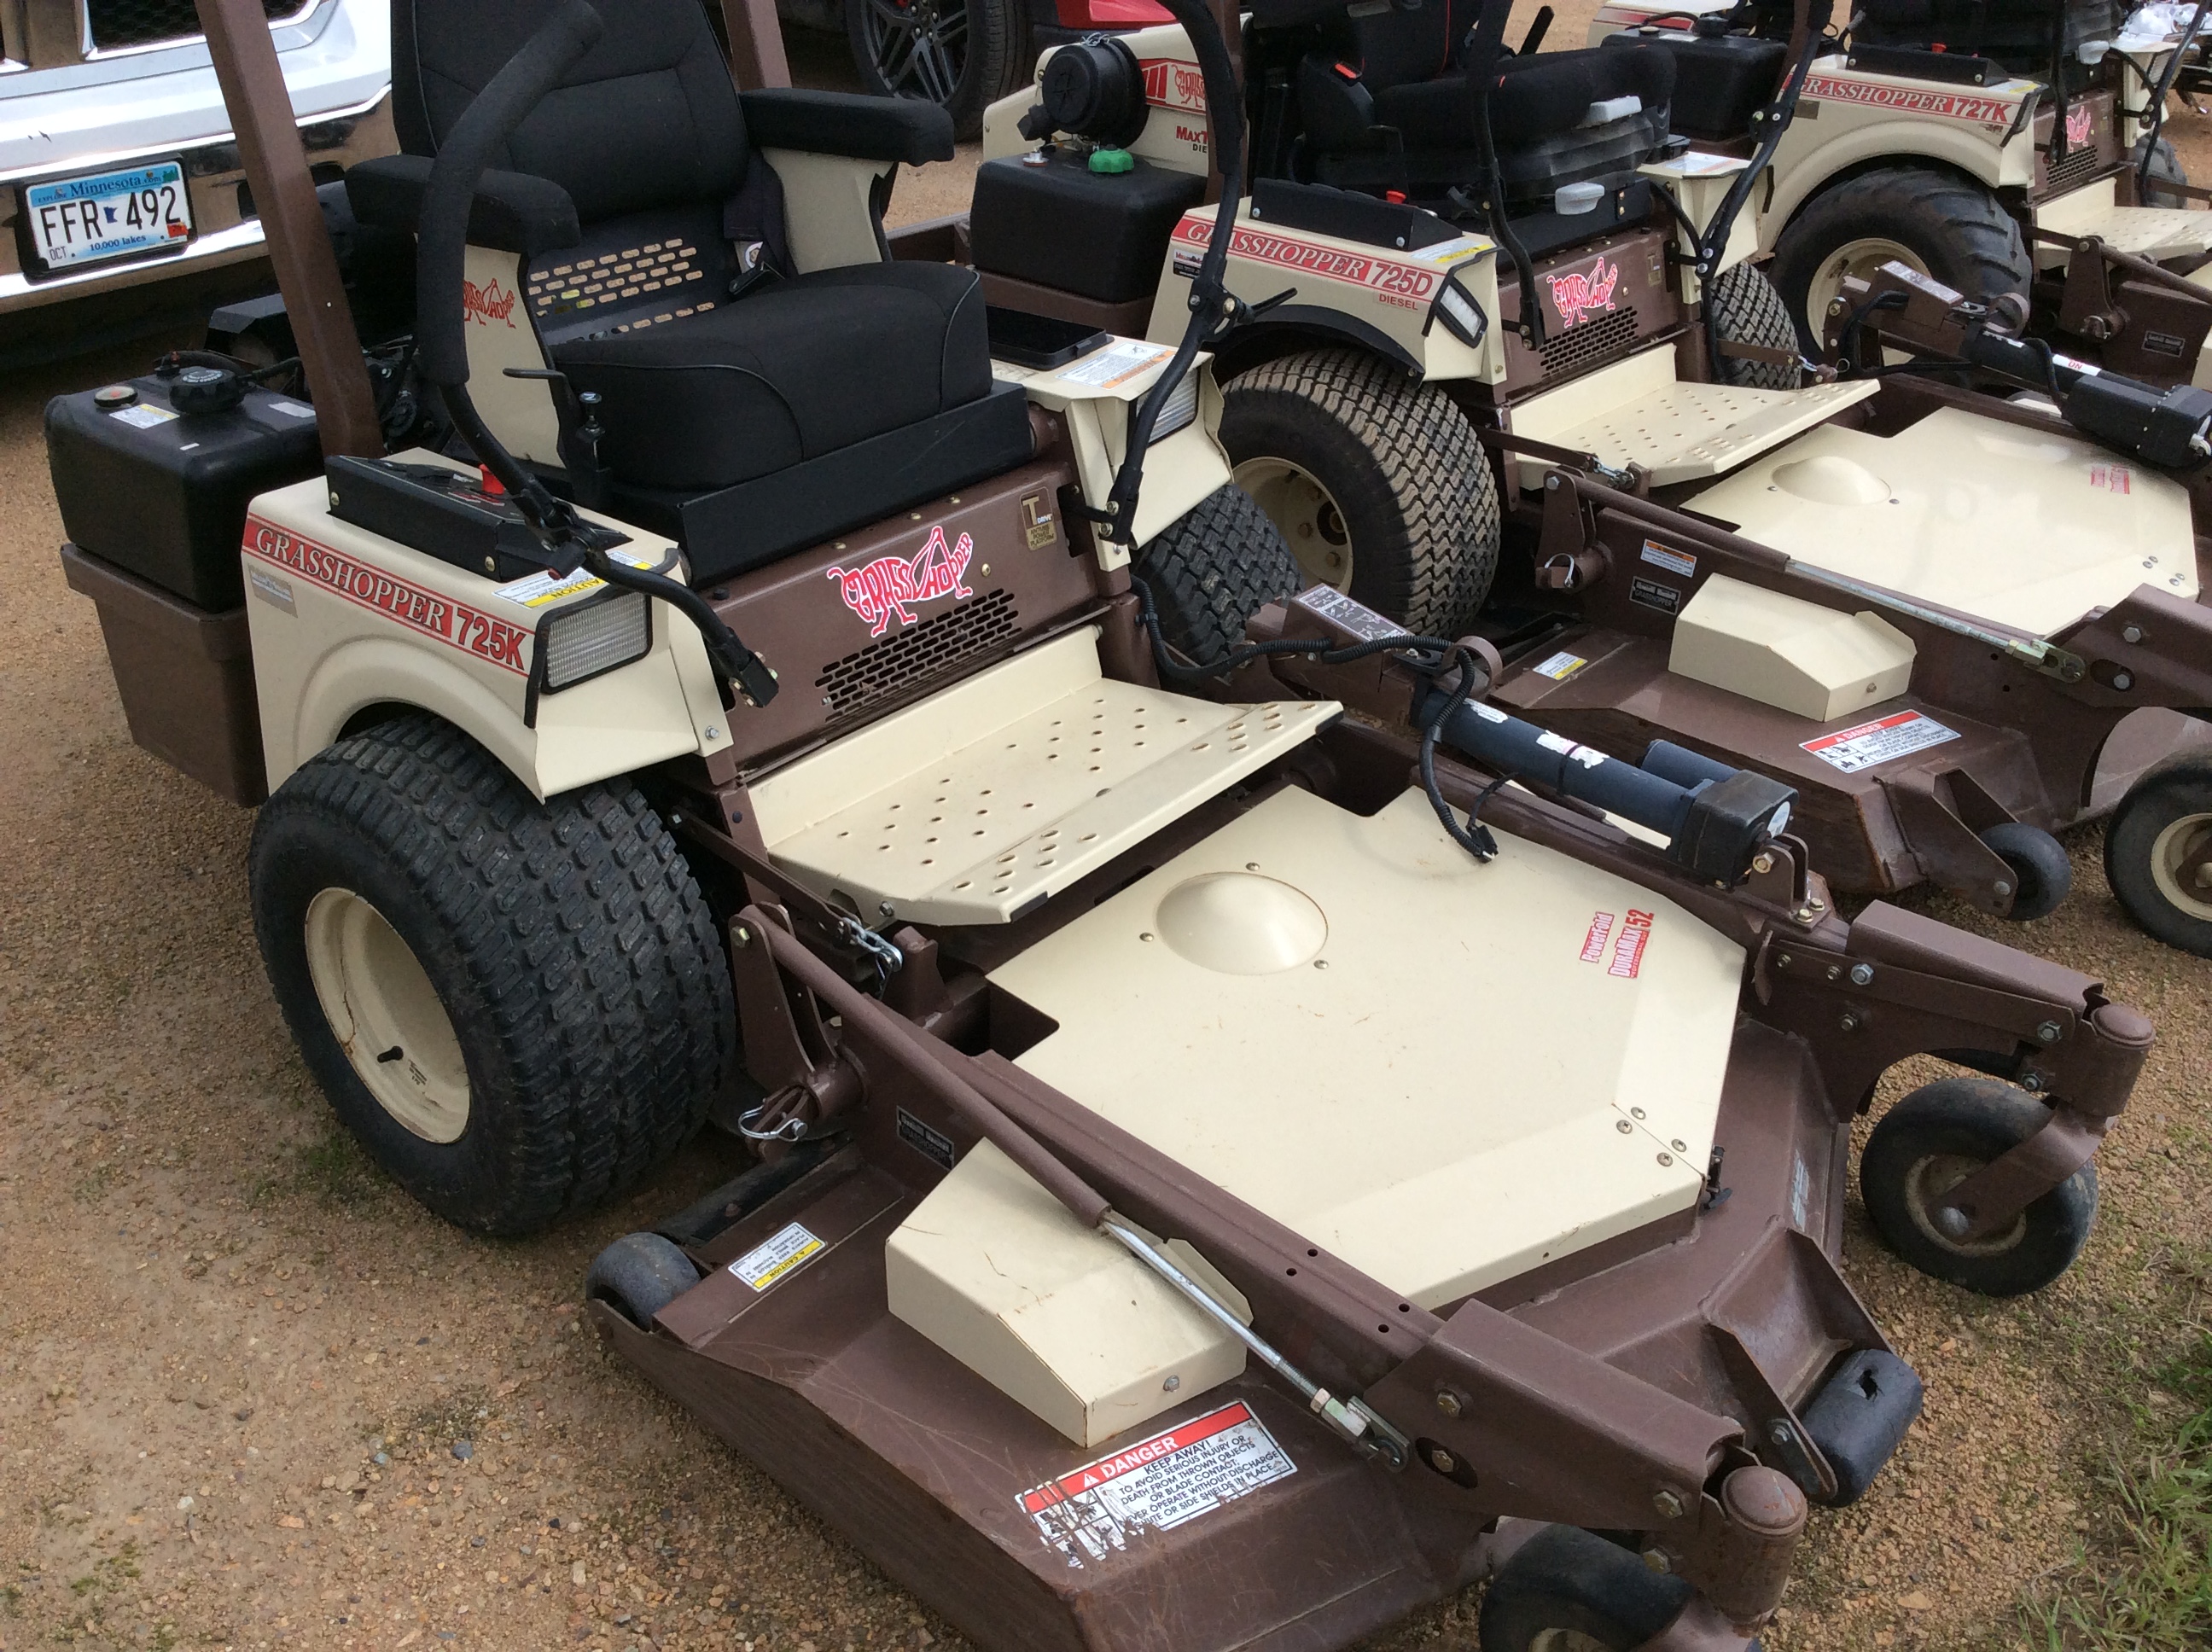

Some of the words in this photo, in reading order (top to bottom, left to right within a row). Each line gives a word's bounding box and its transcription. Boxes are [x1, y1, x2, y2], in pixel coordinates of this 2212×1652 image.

[1956, 98, 2012, 123] 727K
[40, 199, 103, 247] FFR
[126, 186, 181, 230] 492
[49, 246, 67, 262] OCT
[90, 241, 119, 252] 10,000
[122, 235, 147, 244] lakes
[1371, 262, 1434, 297] 725D
[1378, 293, 1418, 311] DIESEL
[255, 528, 445, 632] GRASSHOPPER
[457, 605, 527, 671] 725K
[1625, 909, 1654, 928] 52
[768, 1254, 798, 1277] CAUTION
[1099, 1434, 1179, 1478] DANGER
[1119, 1484, 1133, 1494] TO
[1135, 1471, 1162, 1488] AVOID
[1163, 1455, 1200, 1475] SERIOUS
[1201, 1441, 1230, 1458] INJURY
[1231, 1434, 1245, 1446] OR
[1121, 1487, 1150, 1504] DEATH
[1150, 1475, 1178, 1492] FROM
[1177, 1458, 1217, 1479] THROWN
[1217, 1440, 1255, 1462] OBJECTS
[1143, 1456, 1172, 1475] KEEP
[1175, 1440, 1211, 1462] AWAY!
[1149, 1491, 1189, 1512] OPERATE
[1188, 1473, 1227, 1494] WITHOUT
[1228, 1451, 1278, 1477] DISCHARGE
[1149, 1491, 1164, 1502] OR
[1165, 1478, 1193, 1495] BLADE
[1162, 1505, 1179, 1516] OR
[1179, 1496, 1199, 1509] SIDE
[1199, 1480, 1234, 1500] SHIELDS
[1234, 1475, 1245, 1484] IN
